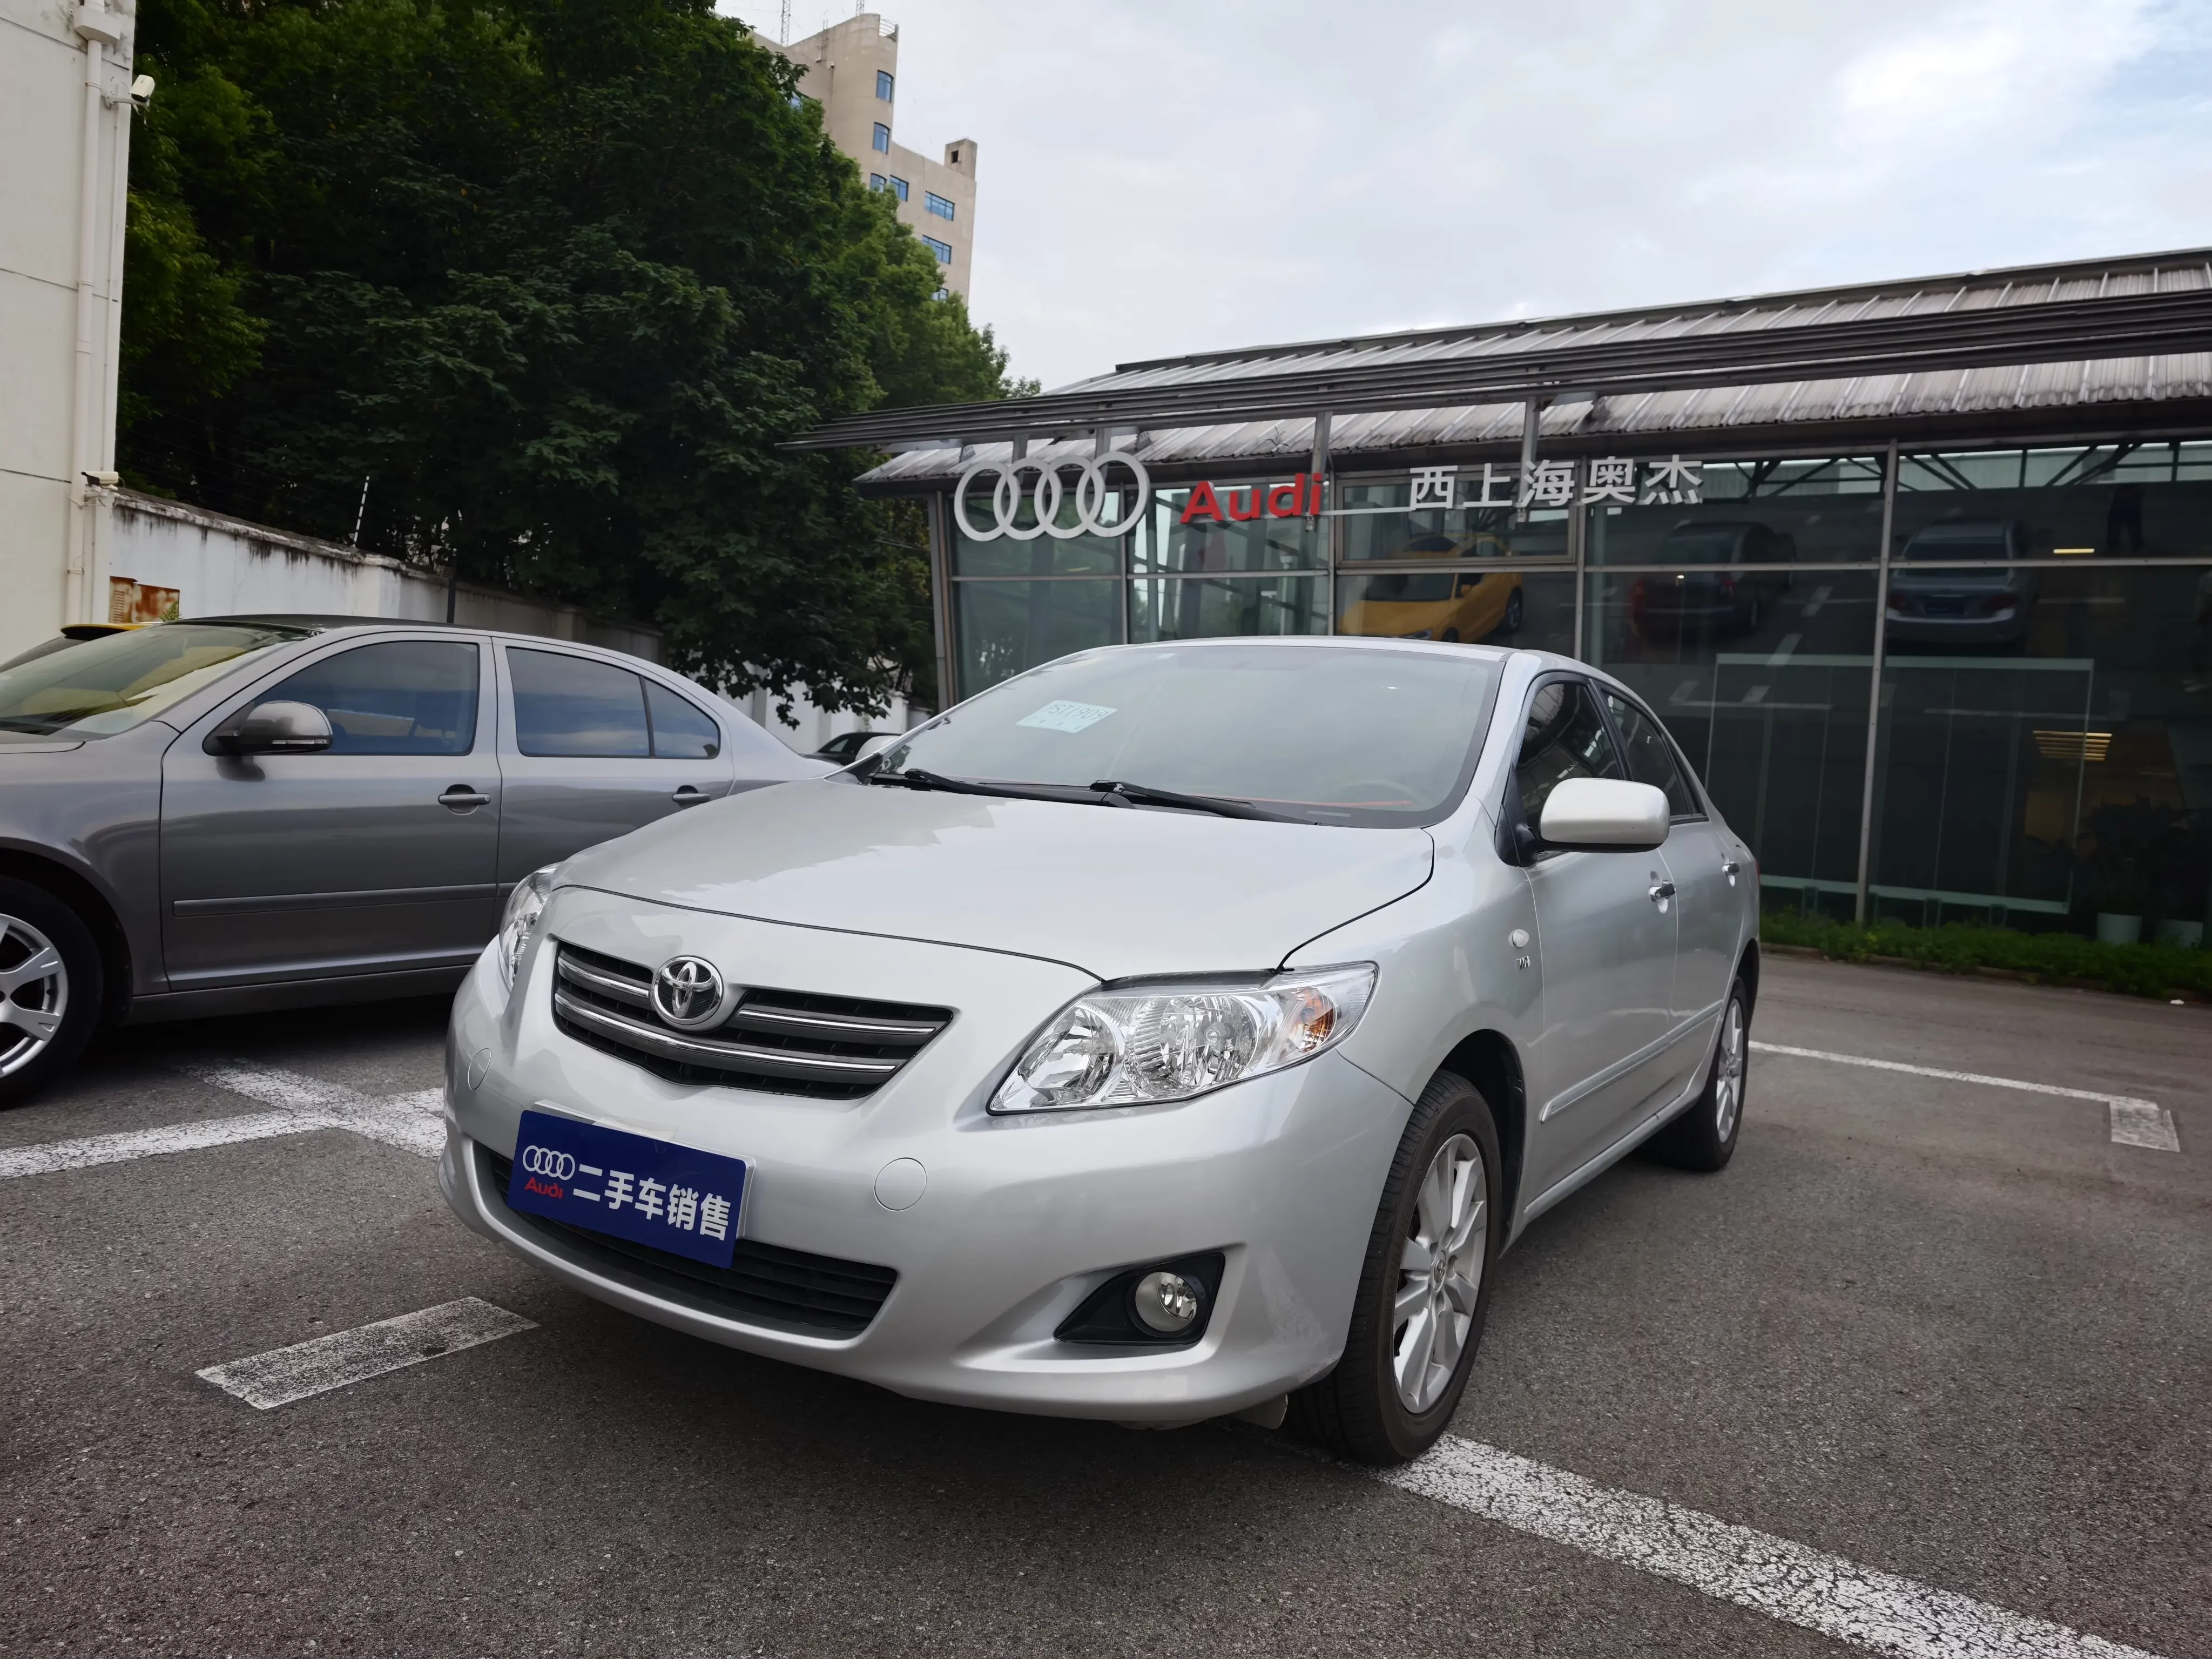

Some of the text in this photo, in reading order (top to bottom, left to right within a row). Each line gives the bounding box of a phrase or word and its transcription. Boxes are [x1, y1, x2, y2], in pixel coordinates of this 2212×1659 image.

[1179, 472, 1323, 524] Audi
[1409, 454, 1703, 510] 西上海奥杰
[524, 1176, 564, 1199] Audi
[572, 1164, 731, 1241] 二手车销售
